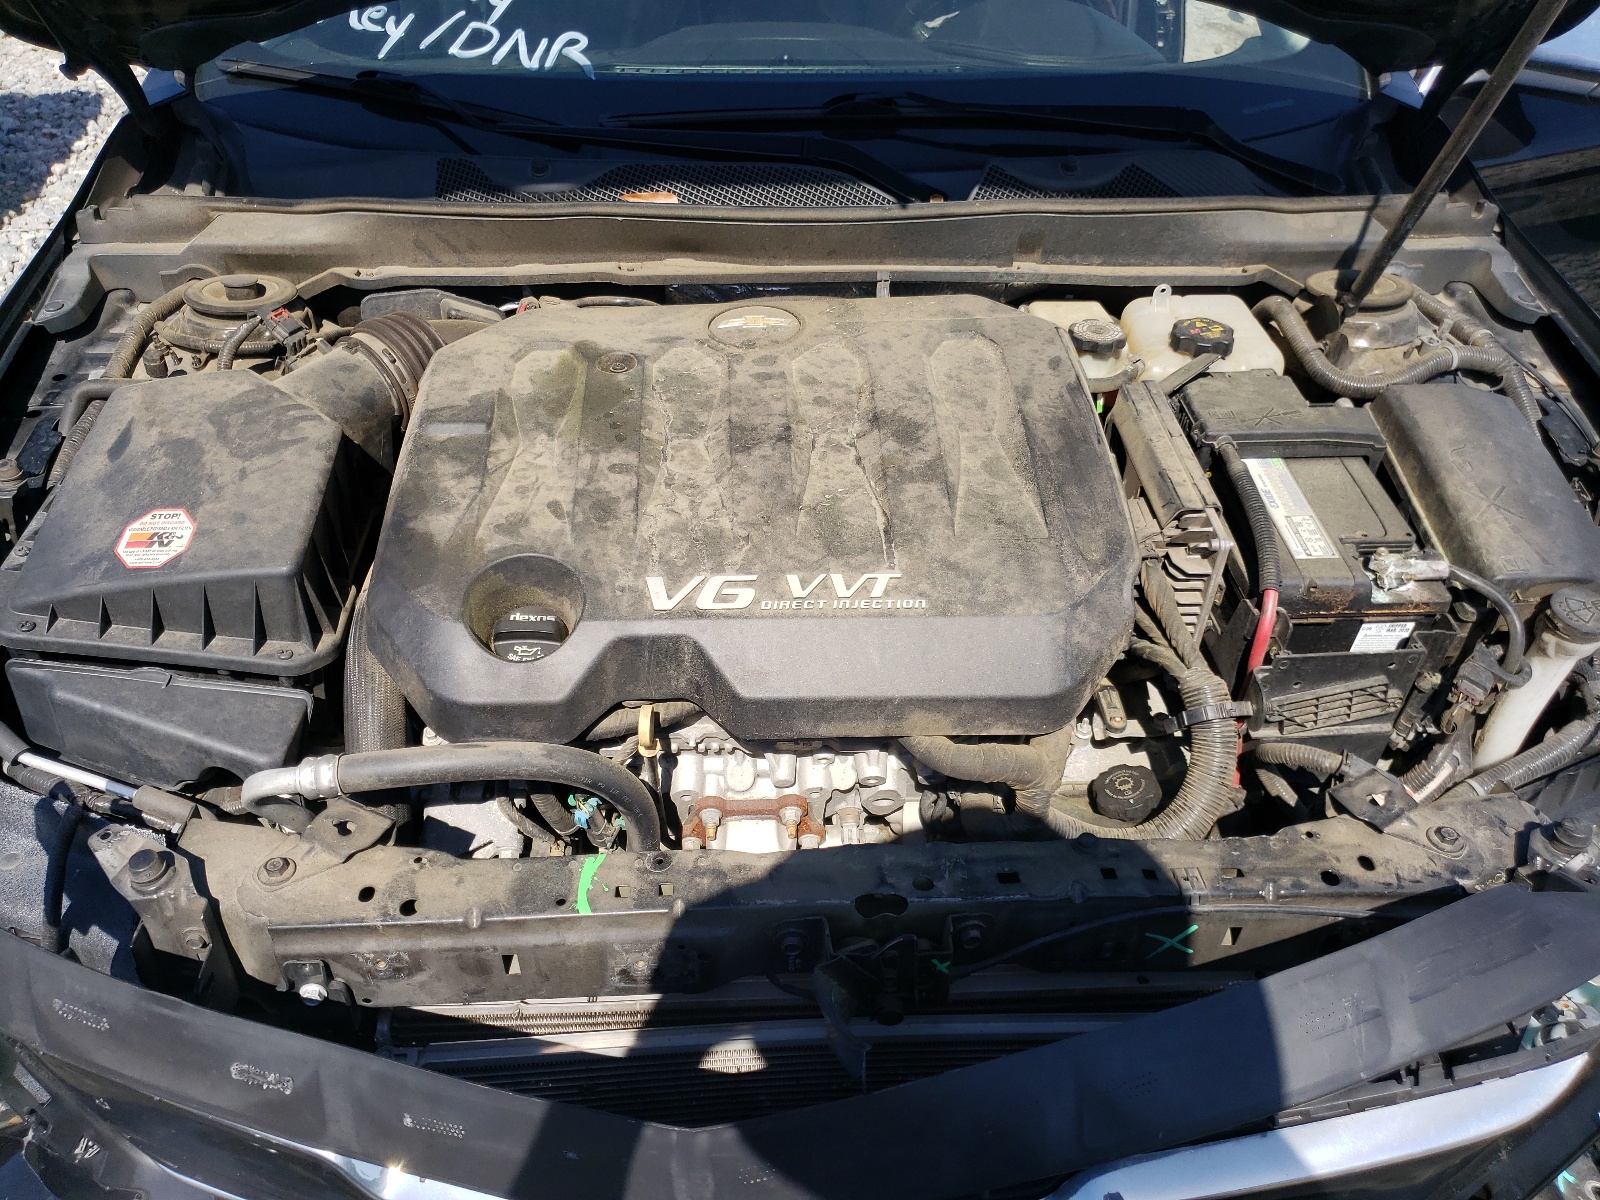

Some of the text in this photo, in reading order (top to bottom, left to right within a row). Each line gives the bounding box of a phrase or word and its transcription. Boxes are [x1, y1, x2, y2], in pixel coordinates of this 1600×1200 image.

[645, 573, 902, 612] V6 VVT
[760, 599, 927, 610] DIRECT INJECTION
